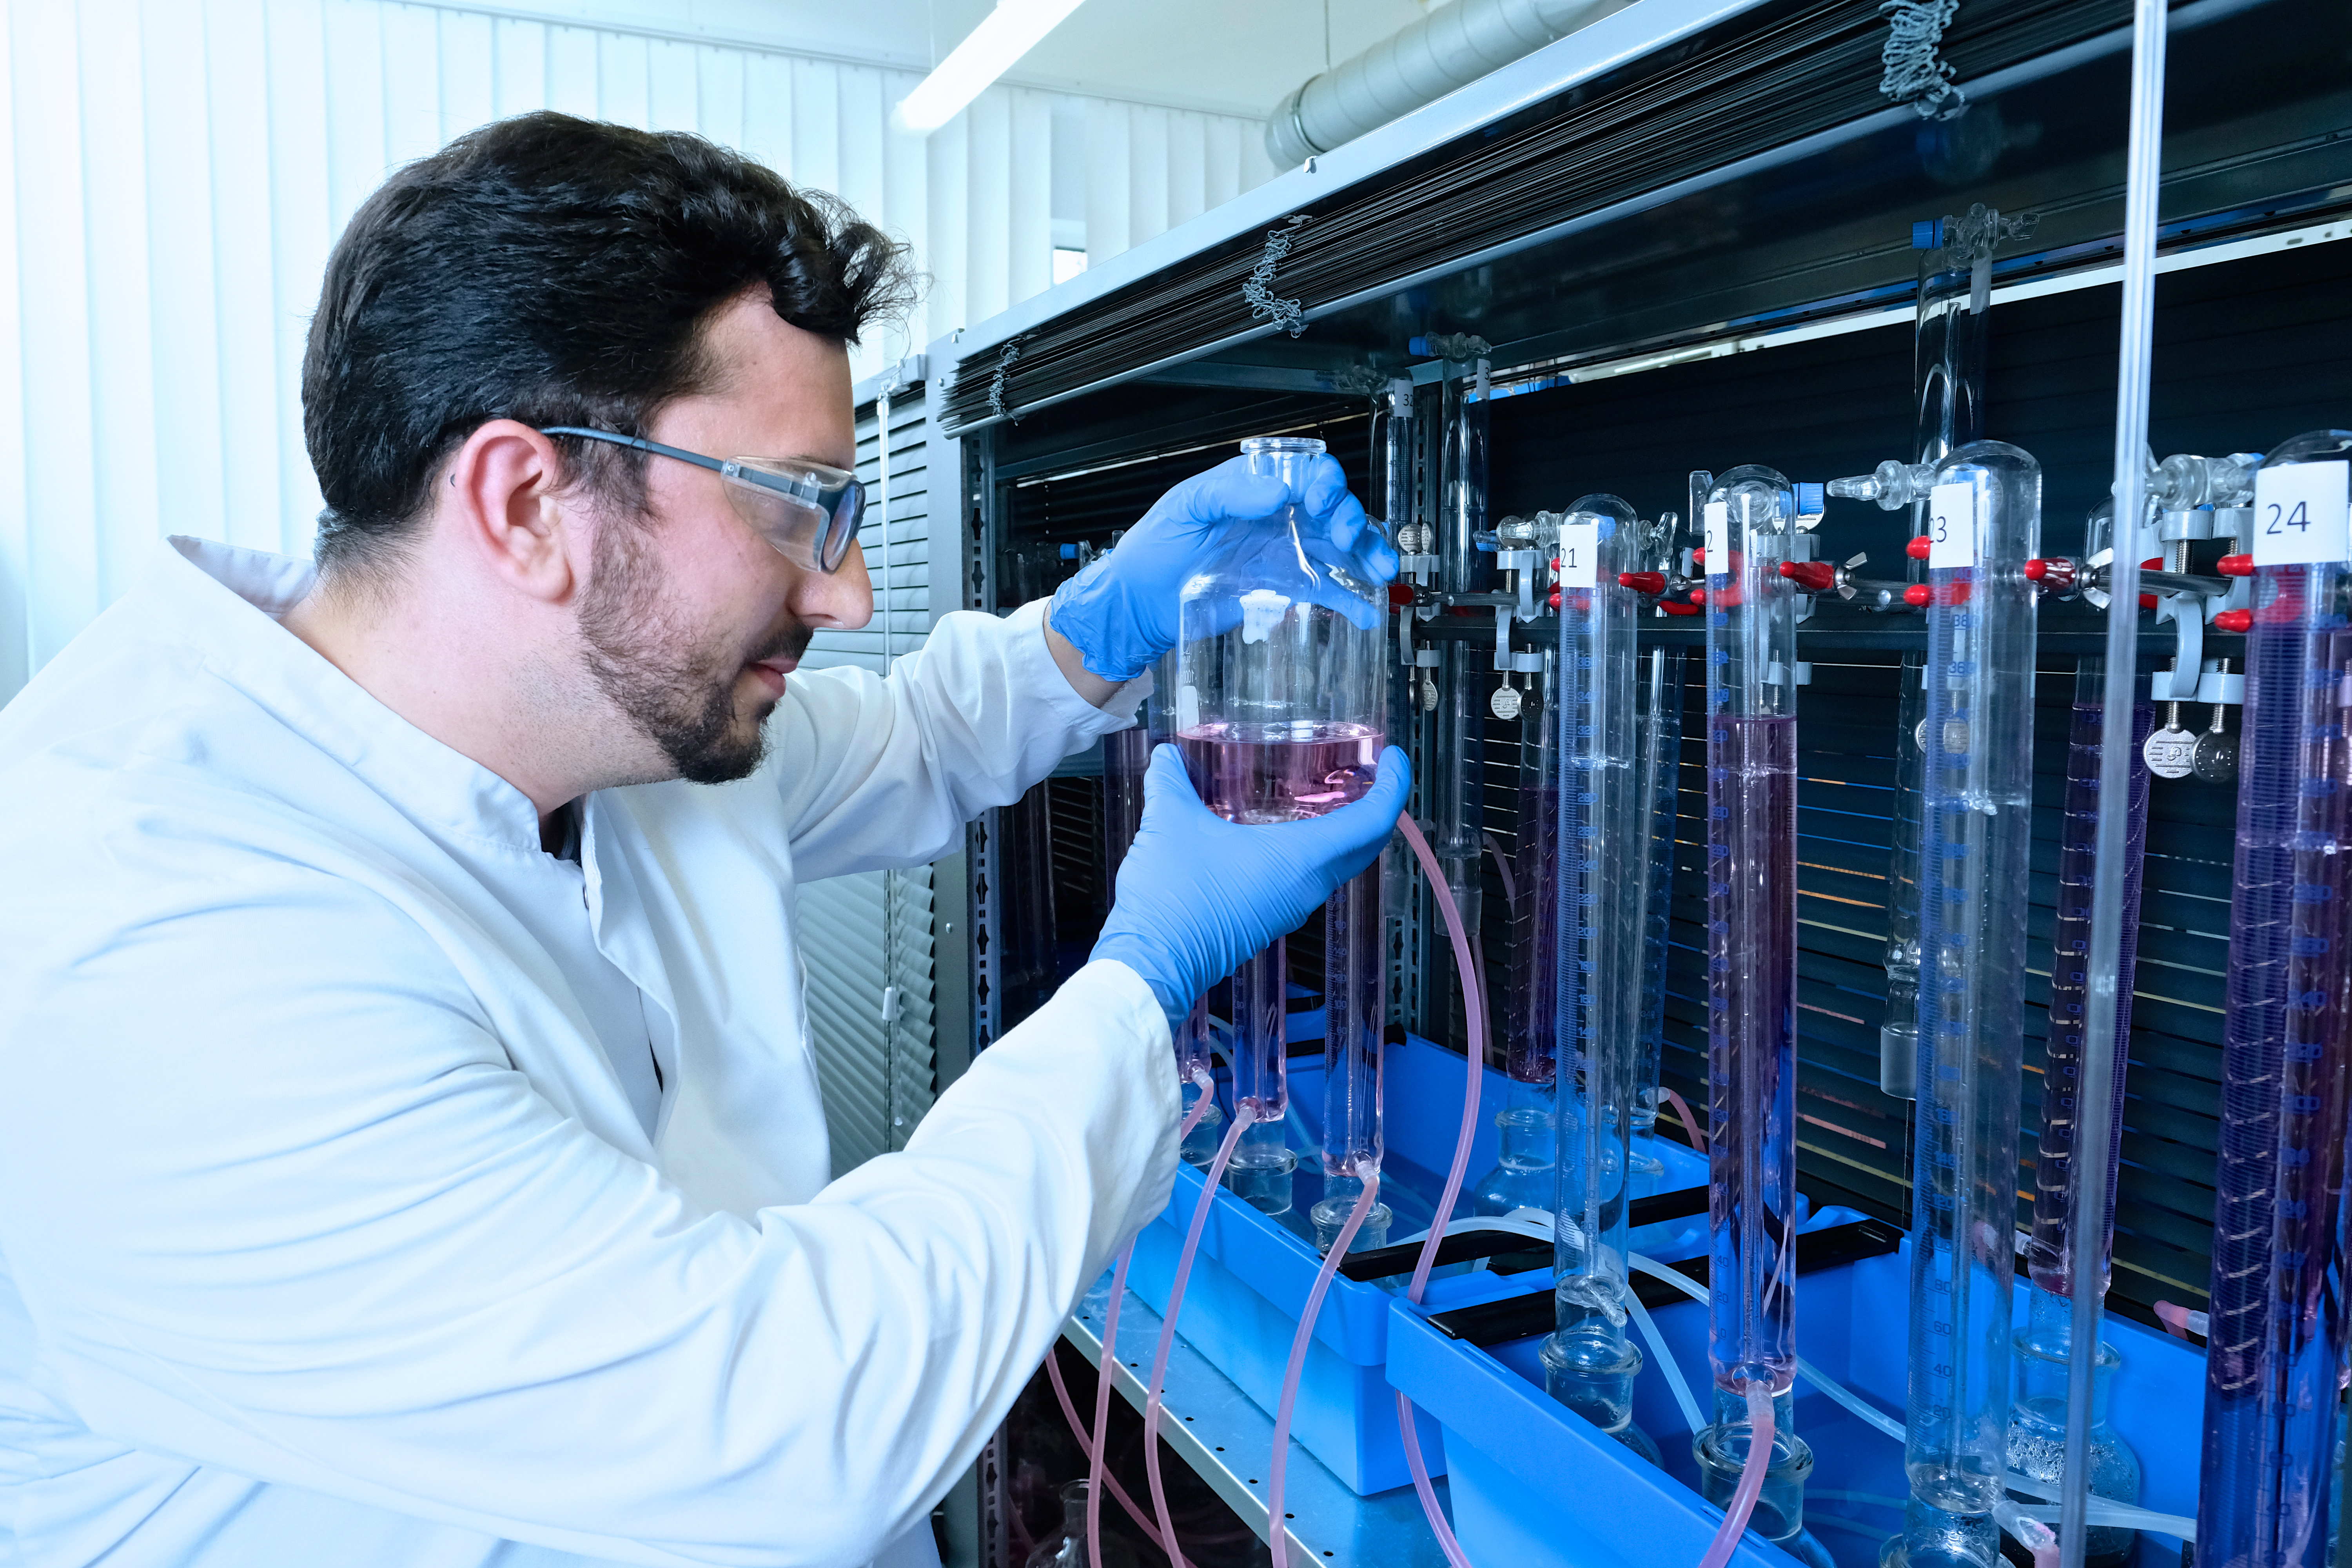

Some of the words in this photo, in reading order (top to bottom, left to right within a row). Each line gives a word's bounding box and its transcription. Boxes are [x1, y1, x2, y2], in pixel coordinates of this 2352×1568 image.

[2267, 501, 2311, 535] 24
[1561, 548, 1577, 568] 21
[1577, 860, 1598, 870] 240
[1577, 927, 1598, 937] 200
[1333, 947, 1347, 956] 140
[1334, 1000, 1347, 1009] 100
[1337, 1026, 1347, 1034] 80
[1578, 1027, 1597, 1037] 140
[1717, 1256, 1729, 1267] 40
[1935, 1279, 1951, 1293] 80
[1717, 1292, 1729, 1303] 20
[1720, 1328, 1726, 1338] 0
[1934, 1321, 1951, 1335] 60
[1933, 1363, 1953, 1377] 40
[1933, 1404, 1951, 1420] 20
